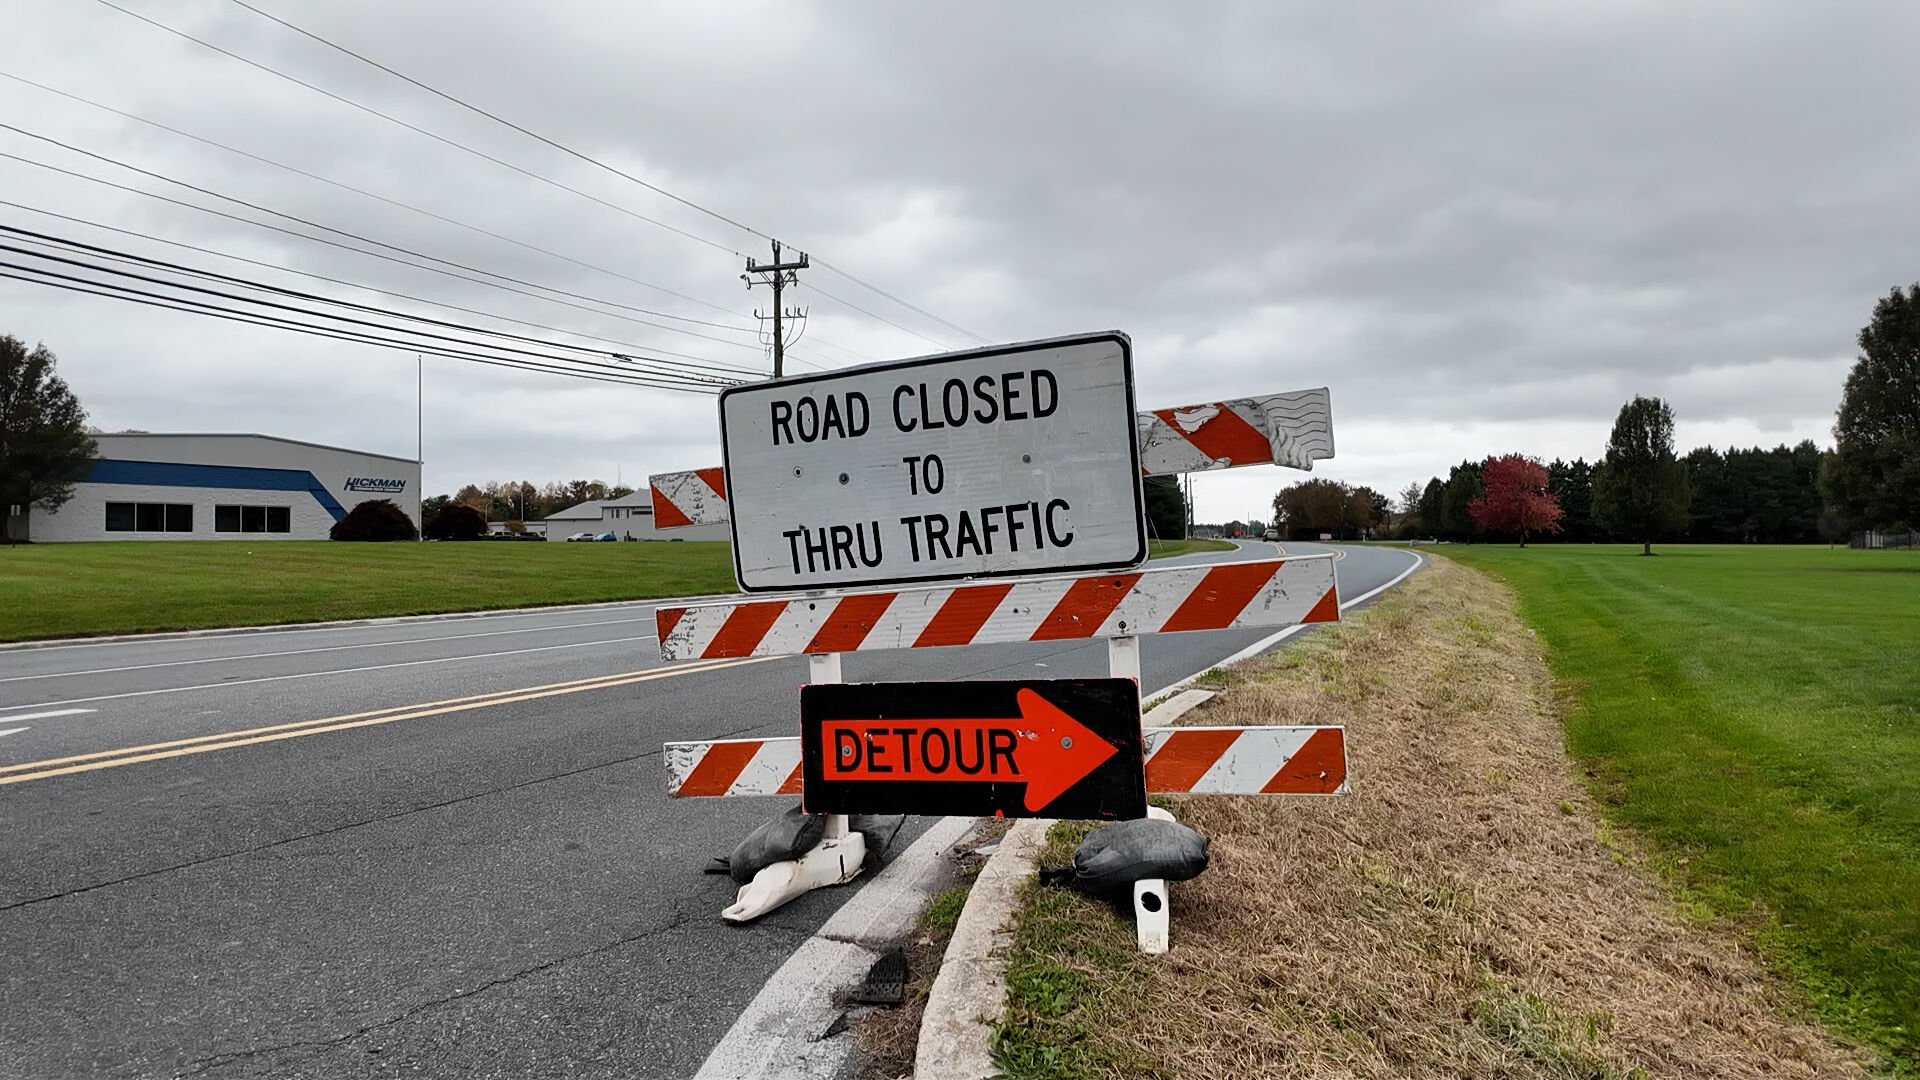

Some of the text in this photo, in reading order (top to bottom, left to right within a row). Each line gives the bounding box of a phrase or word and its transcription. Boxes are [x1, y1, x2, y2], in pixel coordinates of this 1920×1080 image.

[771, 369, 1058, 445] ROAD CLOSED
[344, 477, 406, 490] HICKMAN
[903, 454, 944, 495] TO
[783, 498, 1074, 574] THRU TRAFFIC
[834, 727, 1020, 775] DETOUR
